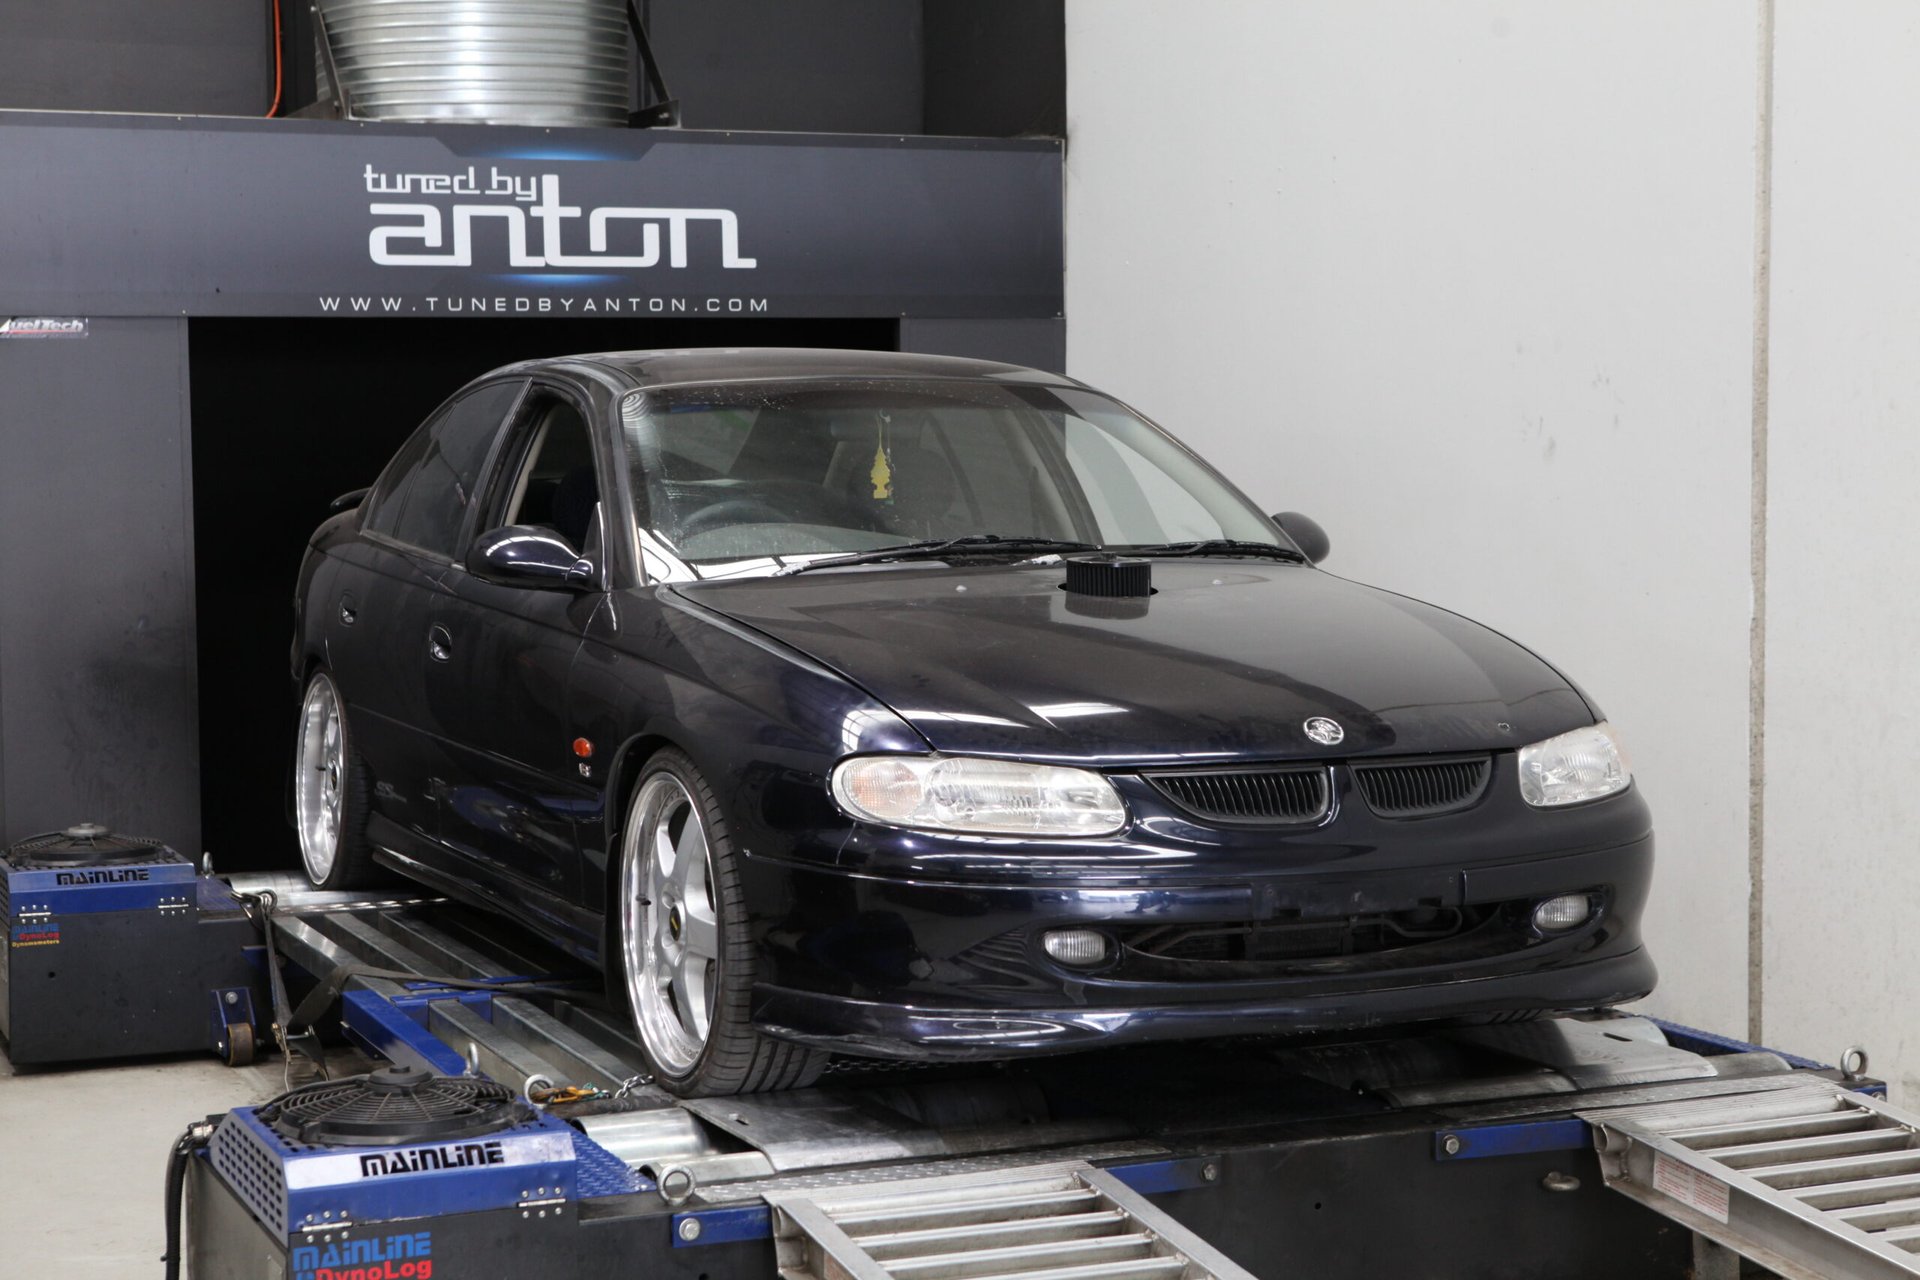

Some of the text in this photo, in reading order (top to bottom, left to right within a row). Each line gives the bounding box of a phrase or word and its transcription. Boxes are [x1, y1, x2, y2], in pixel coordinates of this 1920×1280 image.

[364, 164, 537, 202] tuned by
[368, 174, 757, 269] anton
[319, 297, 769, 312] WWW.TUNEDBYANTON.COM
